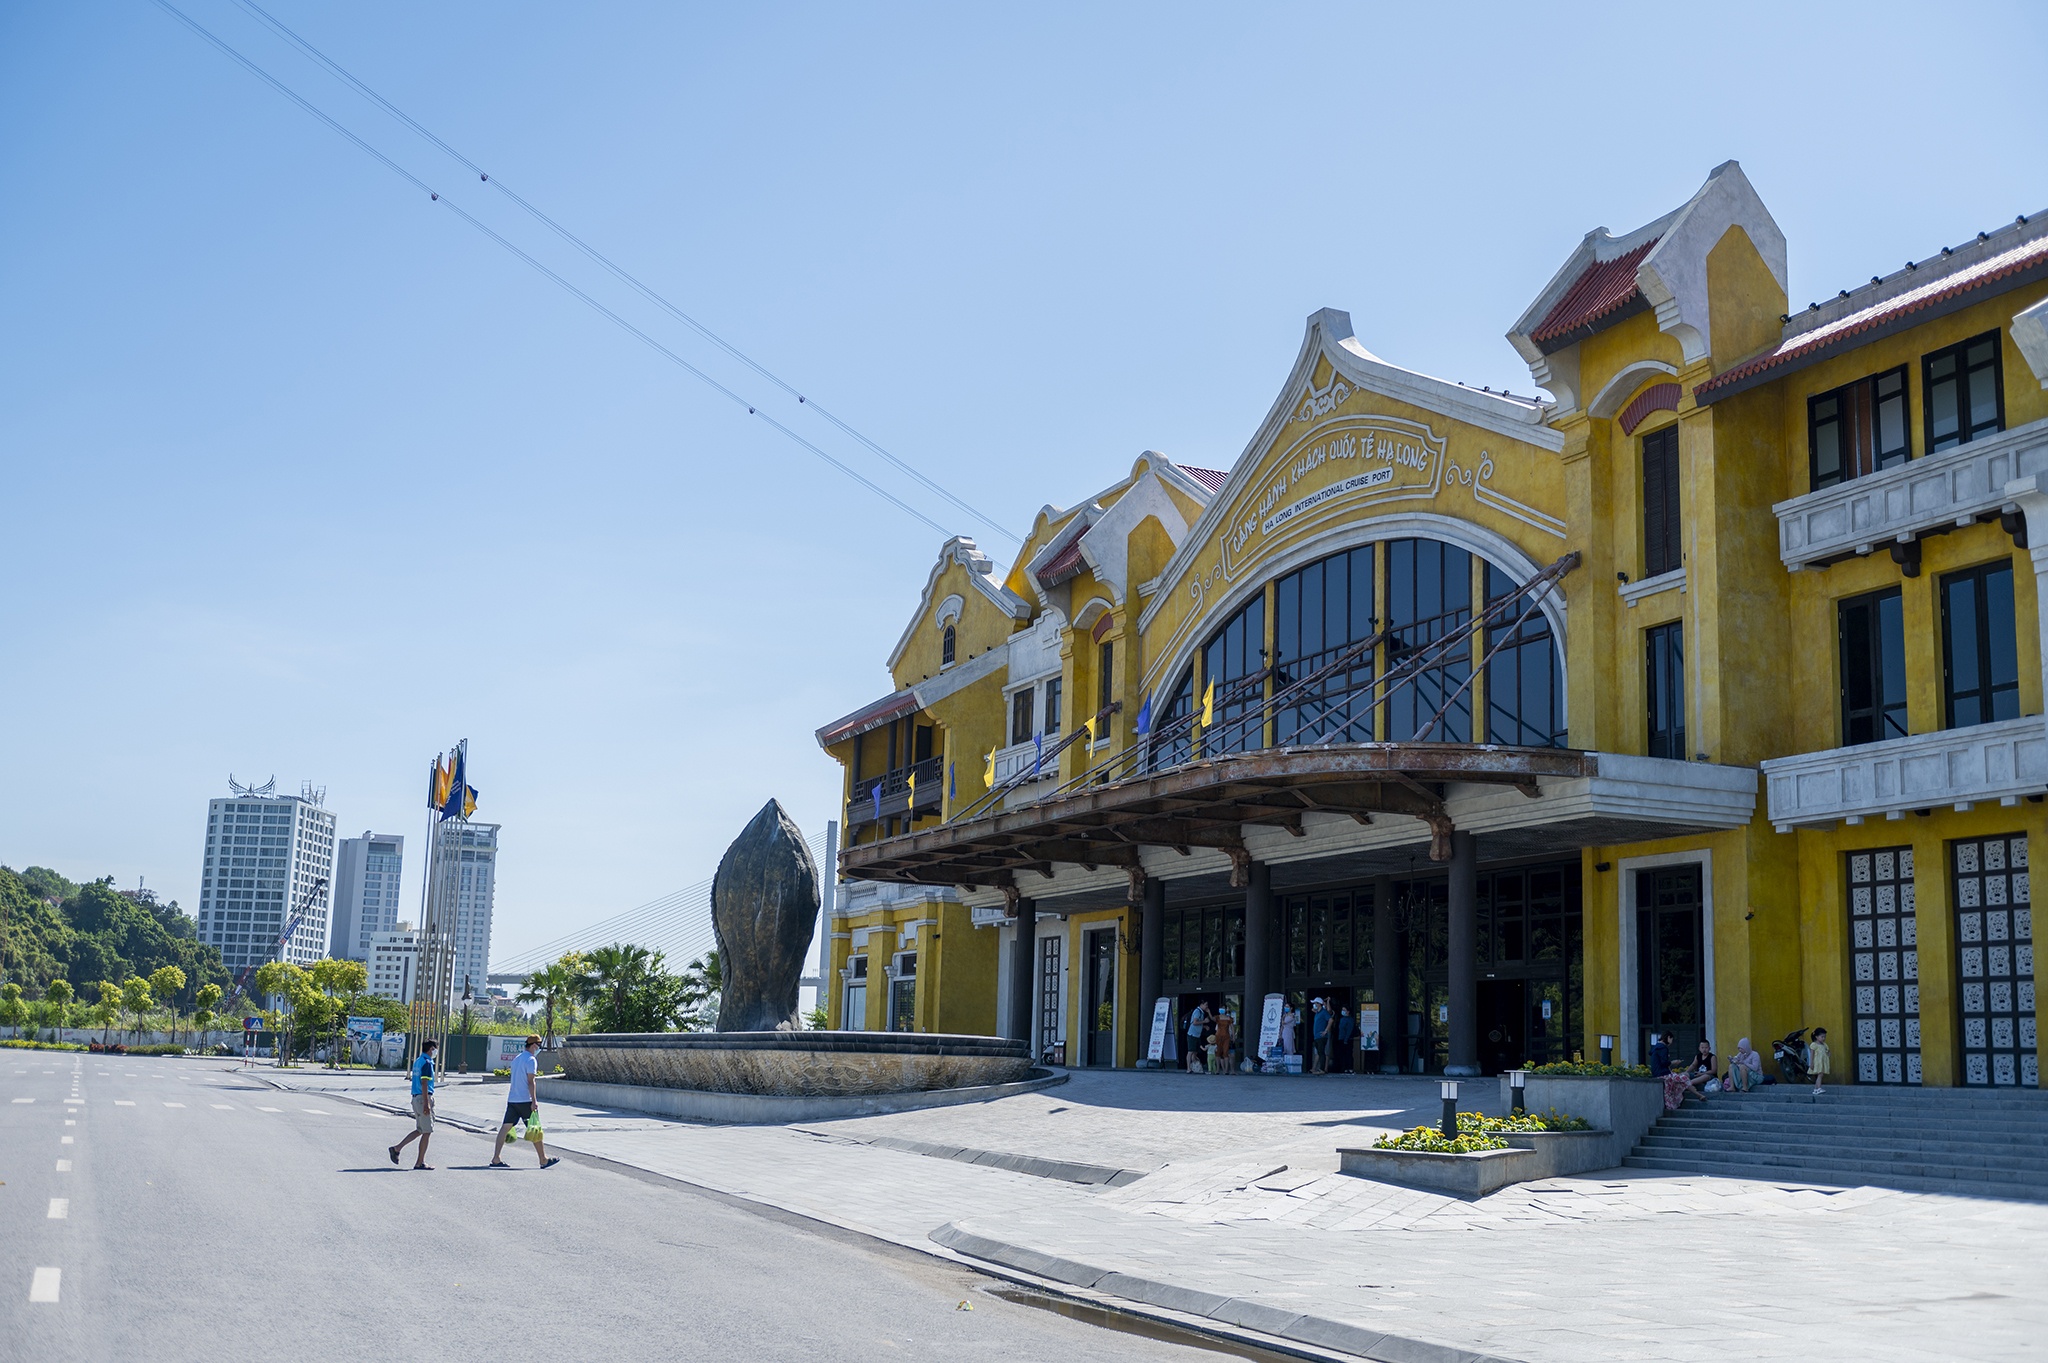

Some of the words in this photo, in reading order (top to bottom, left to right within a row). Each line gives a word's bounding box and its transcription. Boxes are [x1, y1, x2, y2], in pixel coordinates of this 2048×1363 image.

[1259, 476, 1287, 520] HÀNH
[1291, 444, 1327, 485] KHÁCH
[1329, 432, 1356, 460] QUỐC
[1361, 431, 1375, 459] TẾ
[1377, 438, 1394, 465] HẠ
[1396, 442, 1428, 472] LONG
[1265, 519, 1274, 531] HA
[1275, 508, 1292, 524] LONG
[1294, 484, 1344, 512] INTERNATIONAL
[1345, 475, 1369, 490] CRUISE
[1372, 470, 1391, 482] PORT
